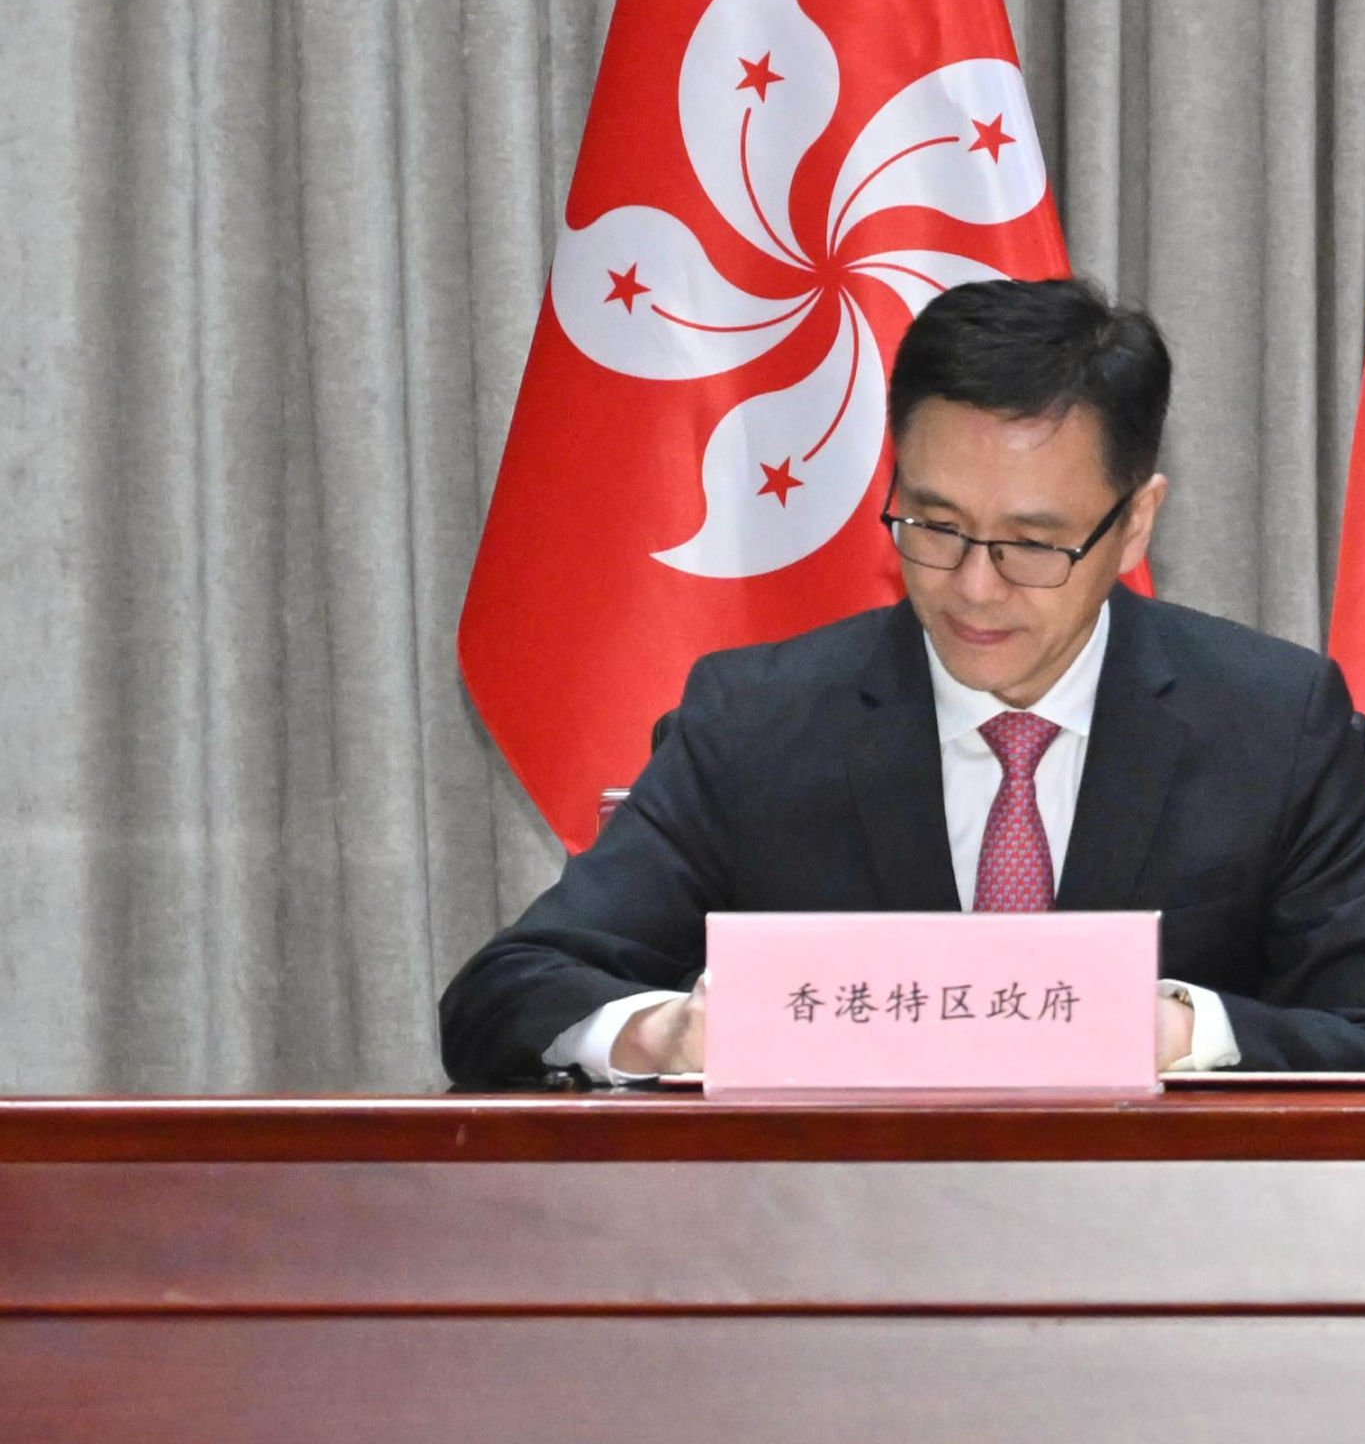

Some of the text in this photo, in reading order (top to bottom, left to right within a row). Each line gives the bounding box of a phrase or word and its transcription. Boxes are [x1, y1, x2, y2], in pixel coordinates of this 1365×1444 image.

[784, 981, 1083, 1024] 香港特区政府
